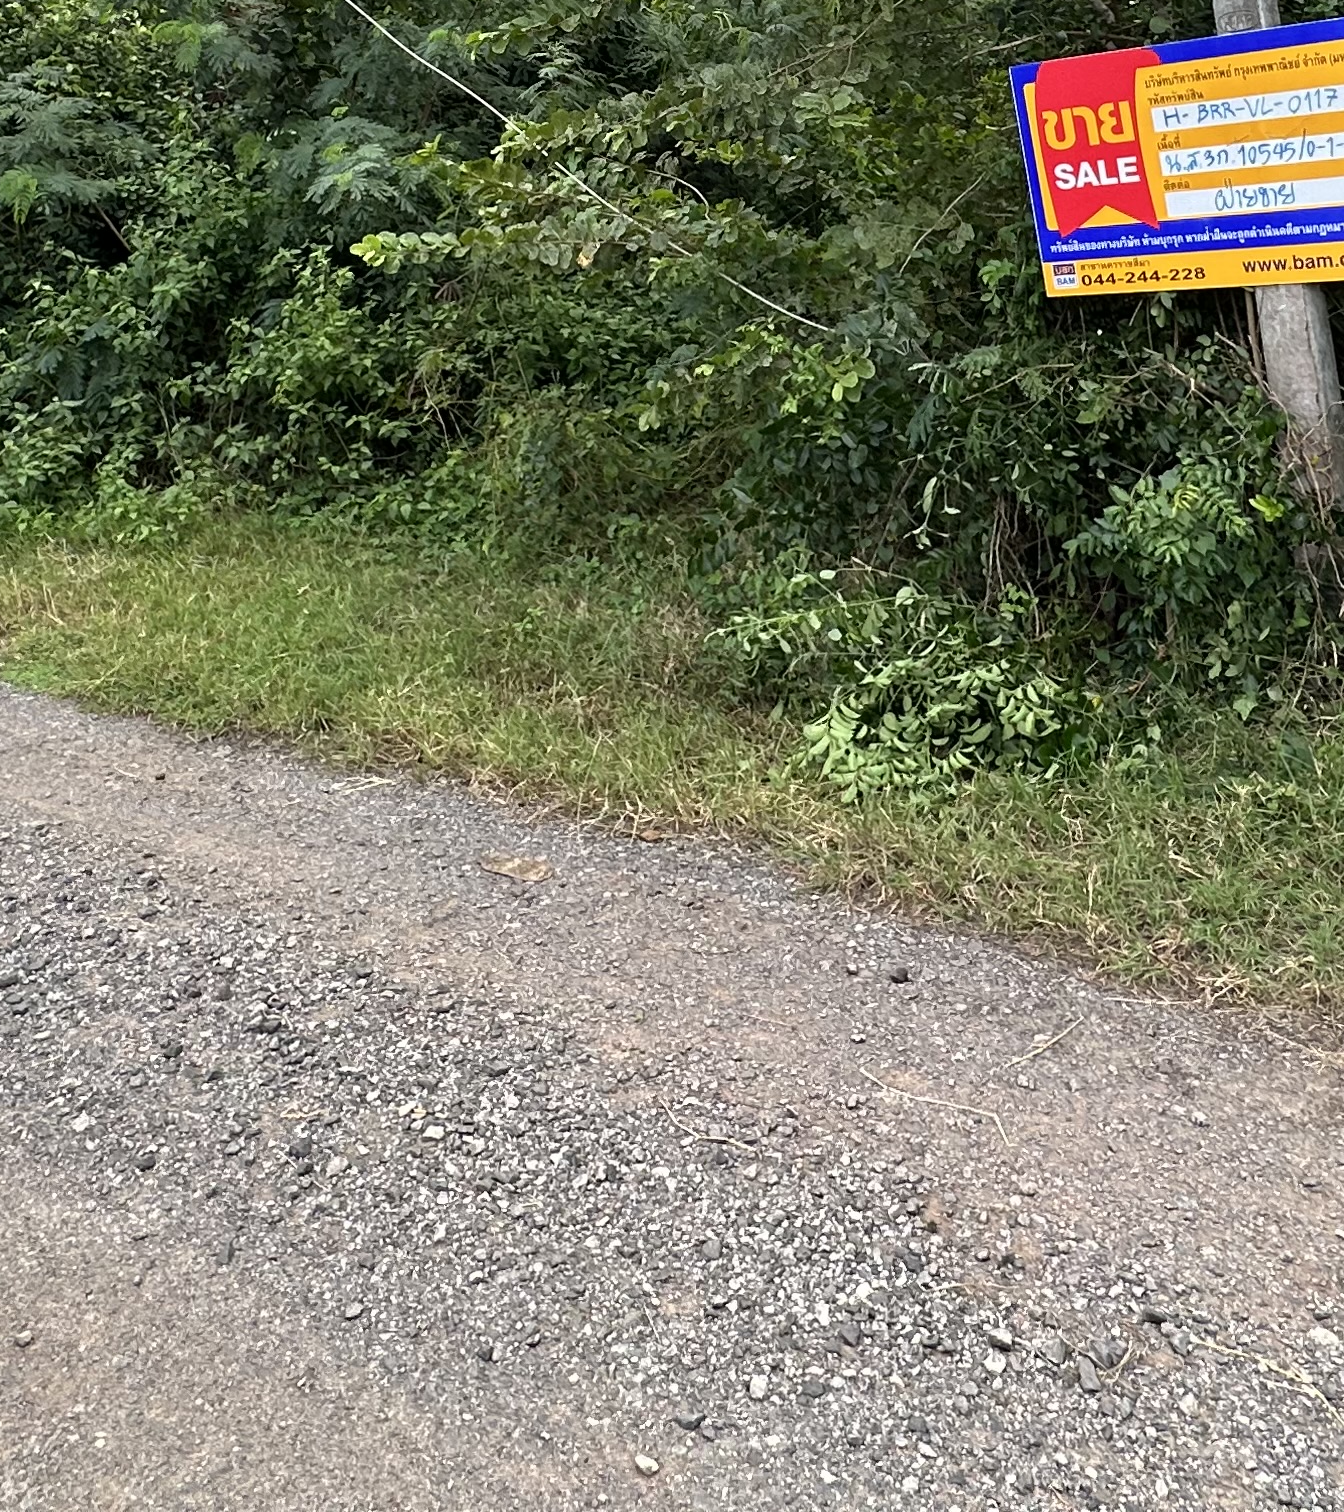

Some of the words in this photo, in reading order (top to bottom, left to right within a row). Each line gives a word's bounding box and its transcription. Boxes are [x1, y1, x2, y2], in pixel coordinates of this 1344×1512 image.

[1302, 52, 1327, 68] จำกัด
[1041, 100, 1136, 150] ขาย
[1157, 133, 1181, 150] เนื้อที่
[1053, 155, 1142, 190] SALE
[1056, 276, 1076, 286] BAM
[1081, 266, 1206, 287] 044-244-228
